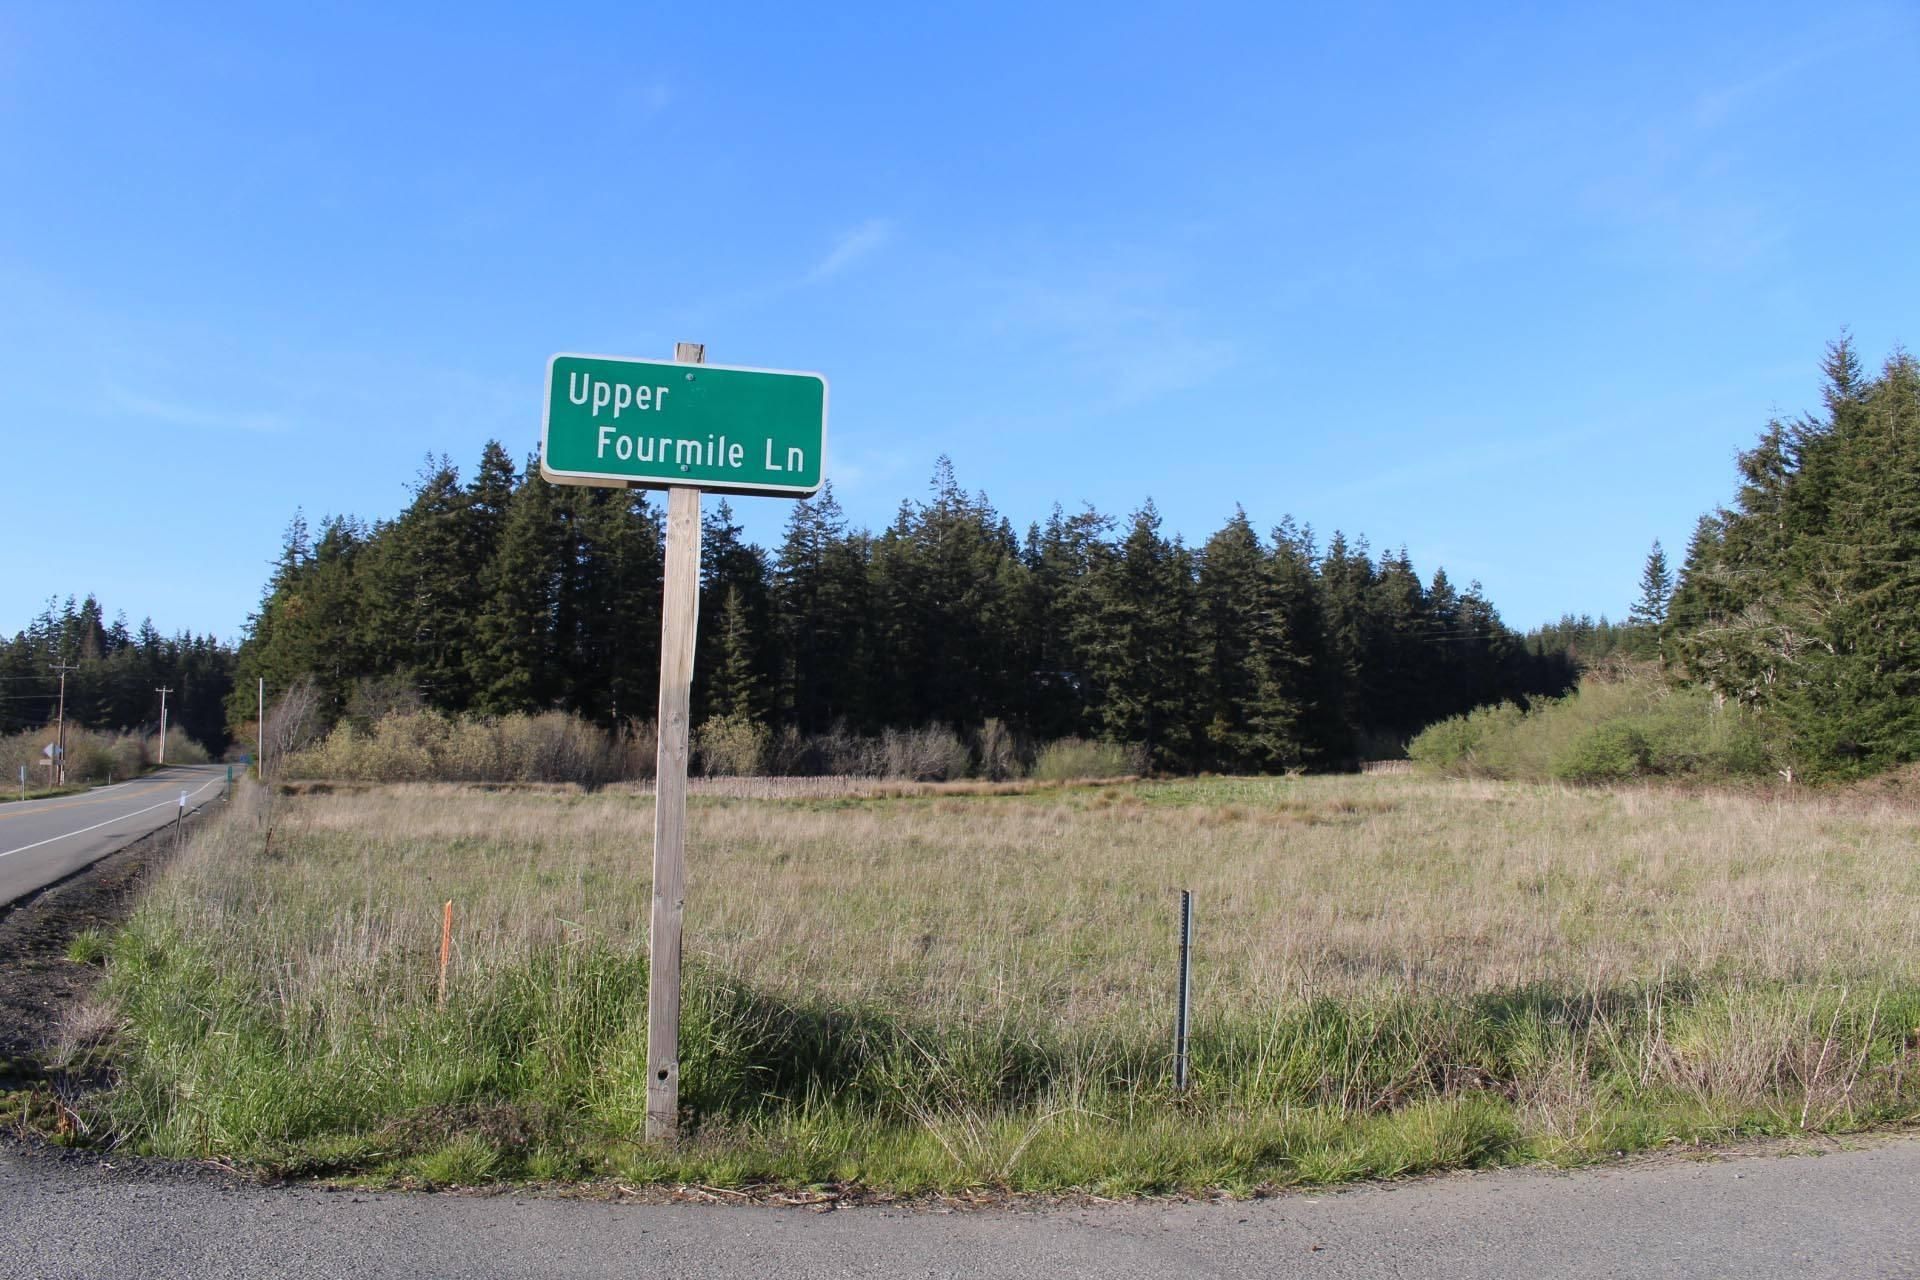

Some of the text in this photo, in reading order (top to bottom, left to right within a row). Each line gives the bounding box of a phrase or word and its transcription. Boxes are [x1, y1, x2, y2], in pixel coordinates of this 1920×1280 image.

[569, 372, 669, 418] Upper
[597, 426, 804, 473] Fourmile Ln
